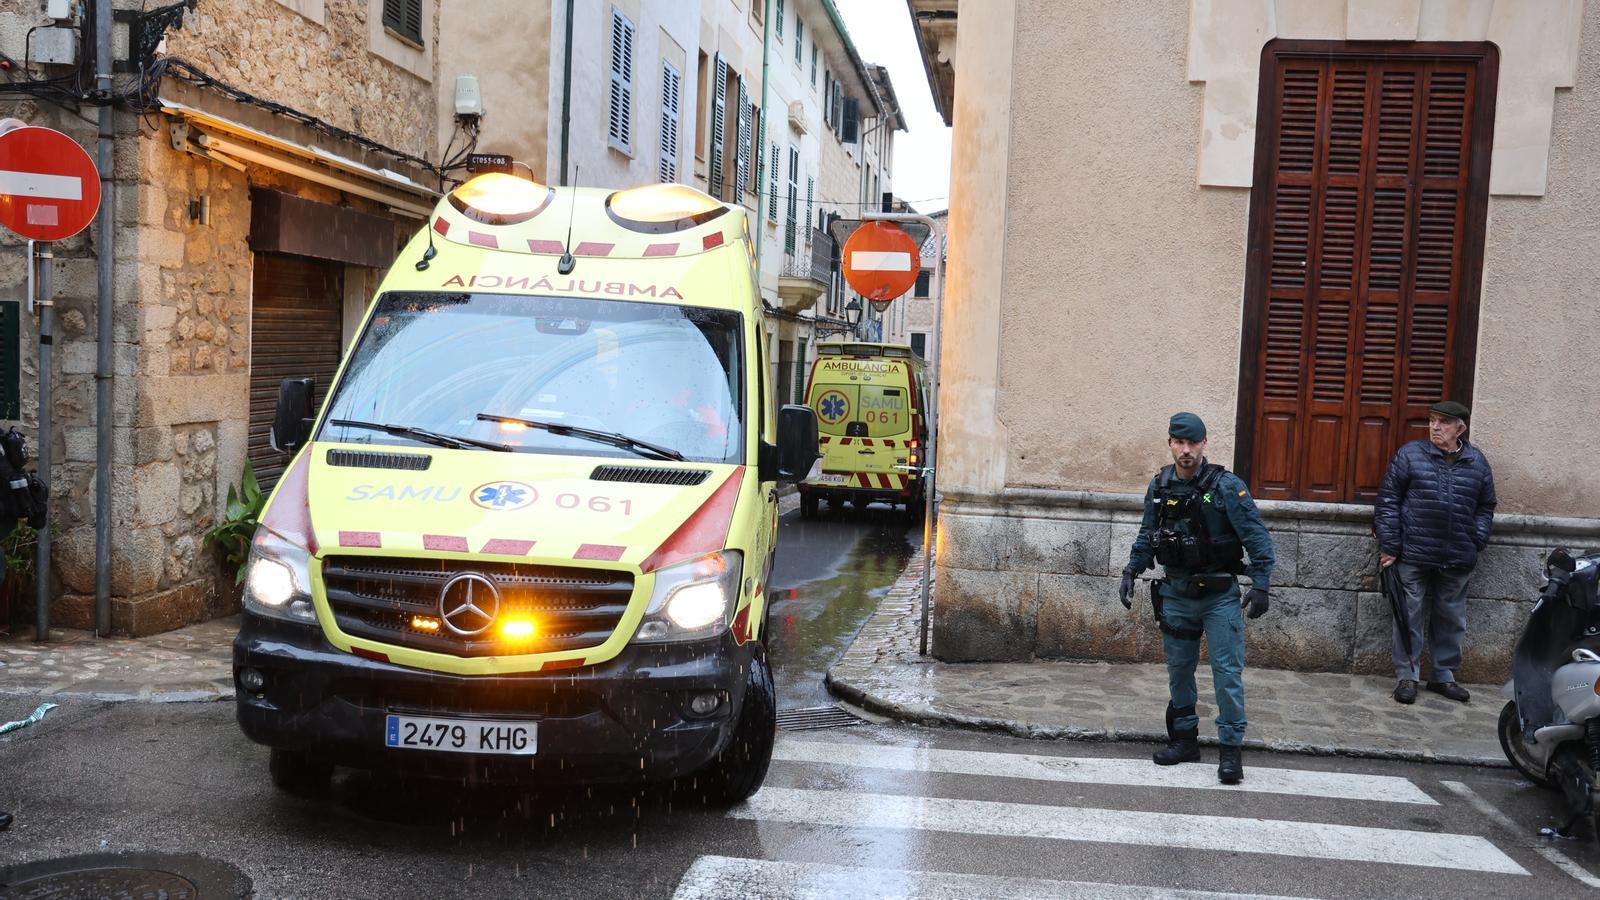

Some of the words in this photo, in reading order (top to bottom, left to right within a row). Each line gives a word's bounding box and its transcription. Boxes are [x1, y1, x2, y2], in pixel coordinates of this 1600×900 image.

[861, 396, 904, 410] SAMU
[866, 410, 898, 424] 061
[345, 484, 462, 501] SAMU
[555, 493, 632, 516] 061
[403, 722, 466, 748] 2479
[479, 726, 527, 750] KHG
